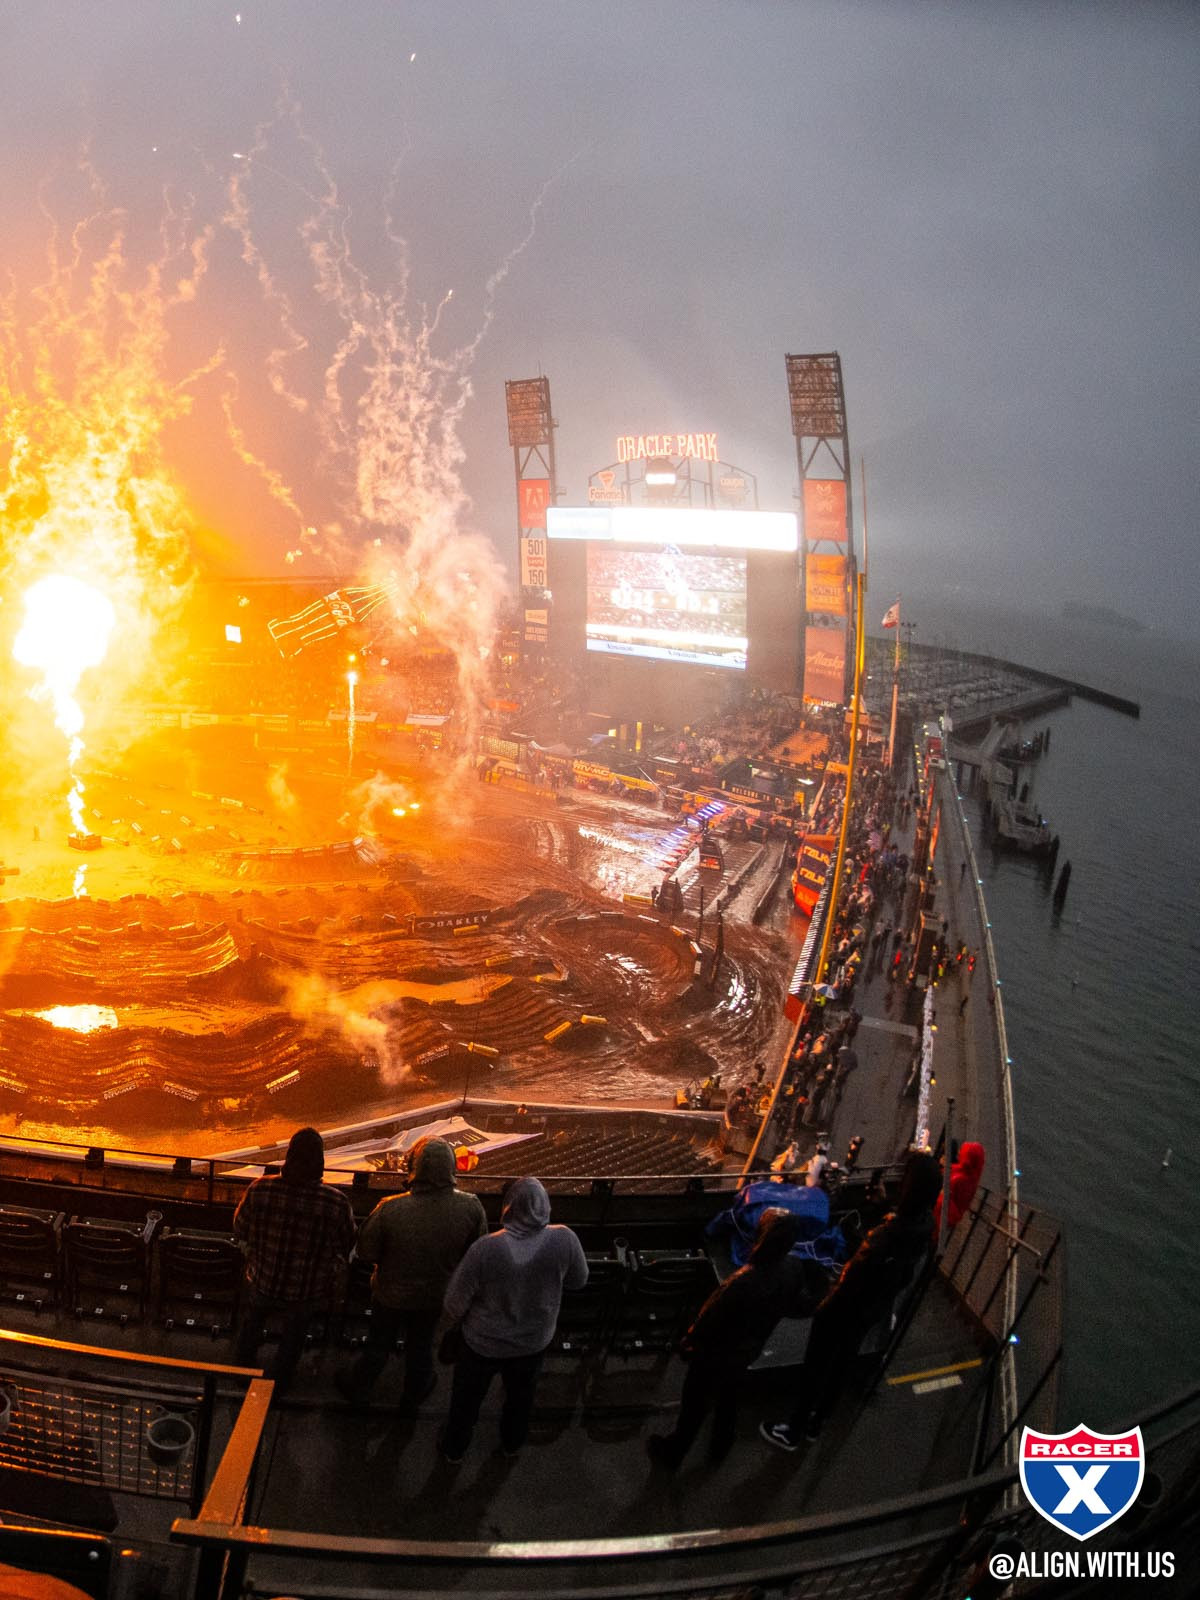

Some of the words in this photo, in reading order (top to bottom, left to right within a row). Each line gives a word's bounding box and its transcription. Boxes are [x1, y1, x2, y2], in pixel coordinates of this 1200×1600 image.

[616, 434, 673, 462] ORACLE
[676, 432, 720, 462] PARK
[527, 539, 545, 555] 501
[528, 569, 545, 585] 150
